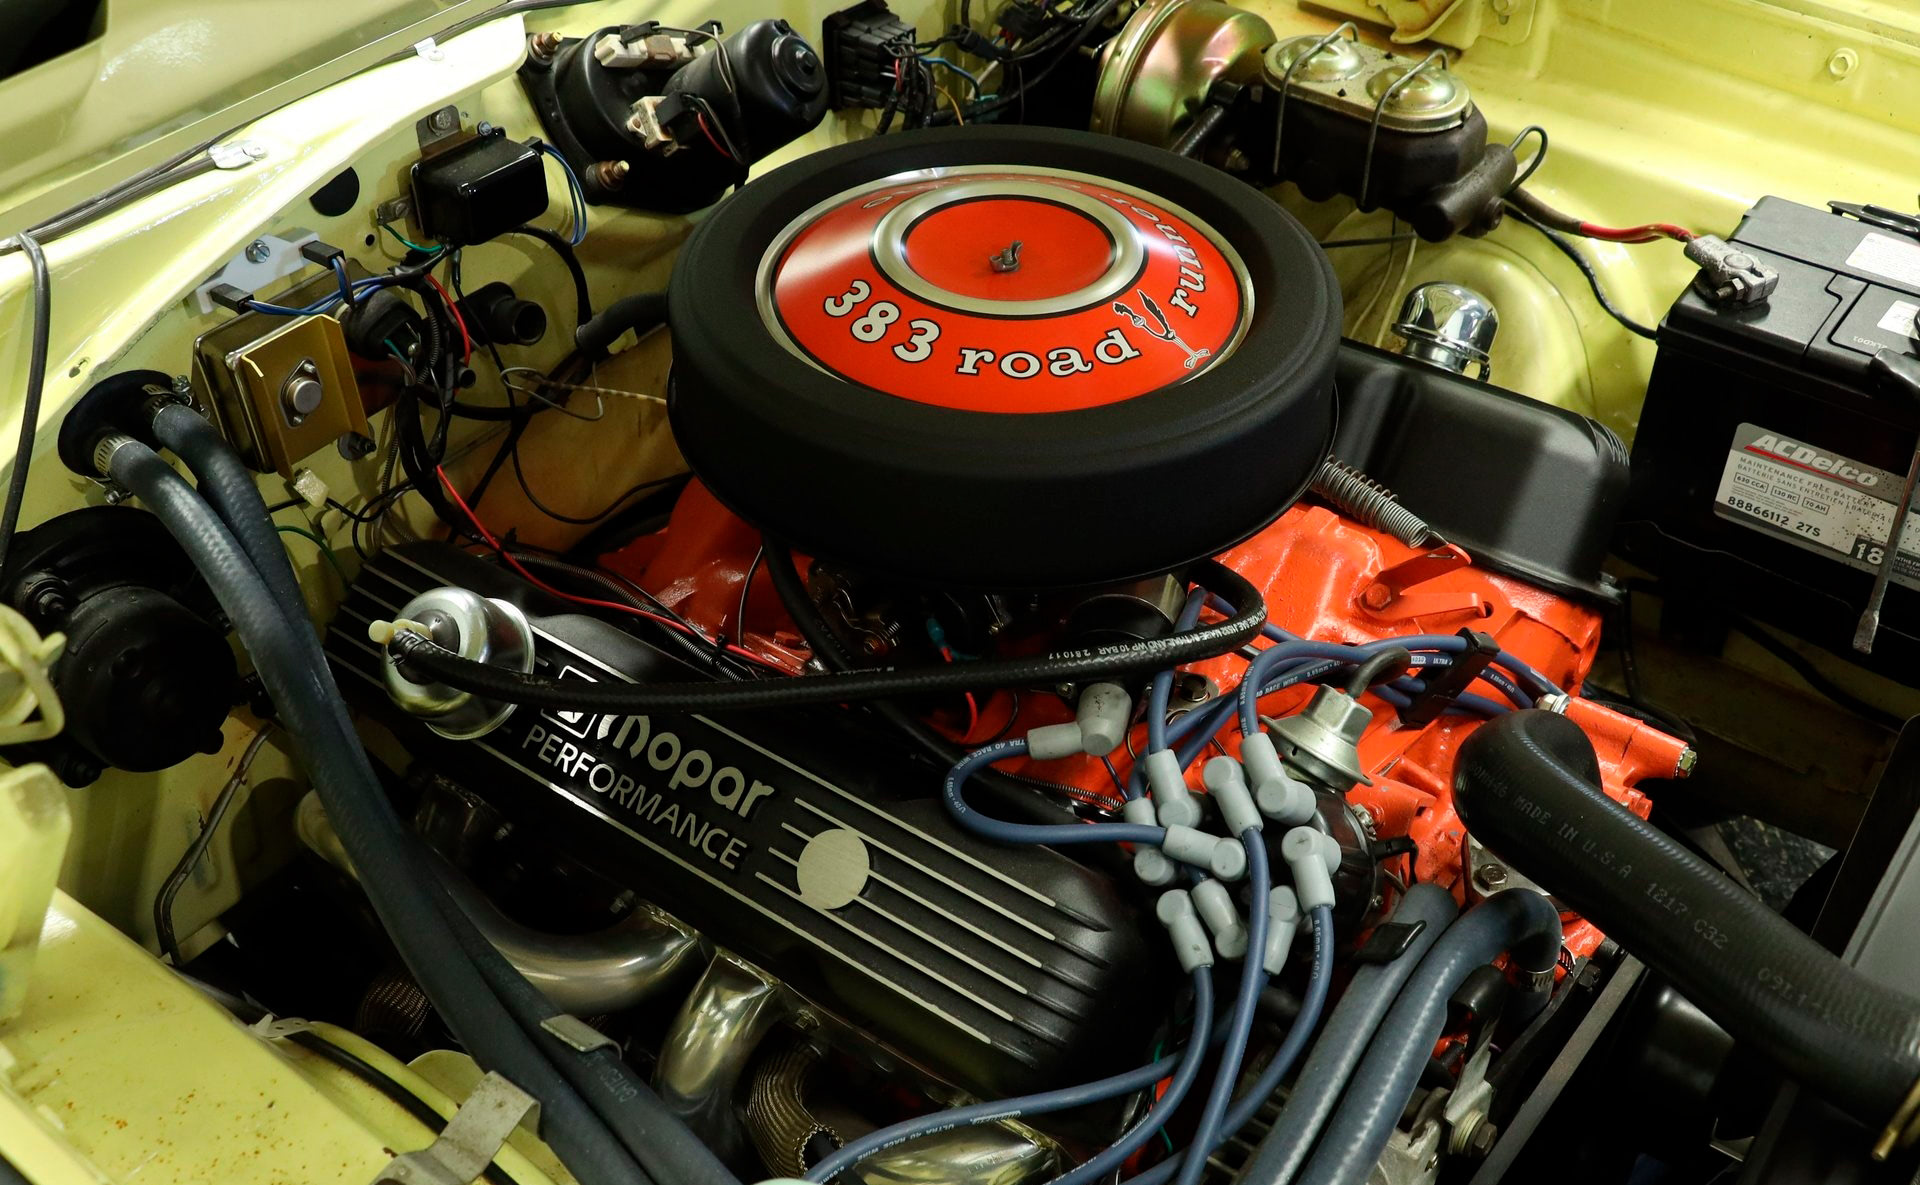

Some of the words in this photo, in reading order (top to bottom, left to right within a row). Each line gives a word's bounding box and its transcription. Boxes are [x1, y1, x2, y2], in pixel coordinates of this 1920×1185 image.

[824, 280, 941, 362] 383
[955, 329, 1141, 379] road
[1740, 457, 1803, 483] MAINTENANCE
[1807, 479, 1830, 493] FREE
[1751, 434, 1879, 486] ACDelco
[1727, 496, 1790, 526] 88866112
[1796, 521, 1821, 537] 27S
[1856, 544, 1885, 565] 18
[1097, 646, 1119, 655] BAR
[1009, 739, 1026, 747] TRA
[522, 724, 748, 870] PERFORMANCE
[1514, 795, 1552, 825] MADE
[1557, 823, 1579, 842] IN
